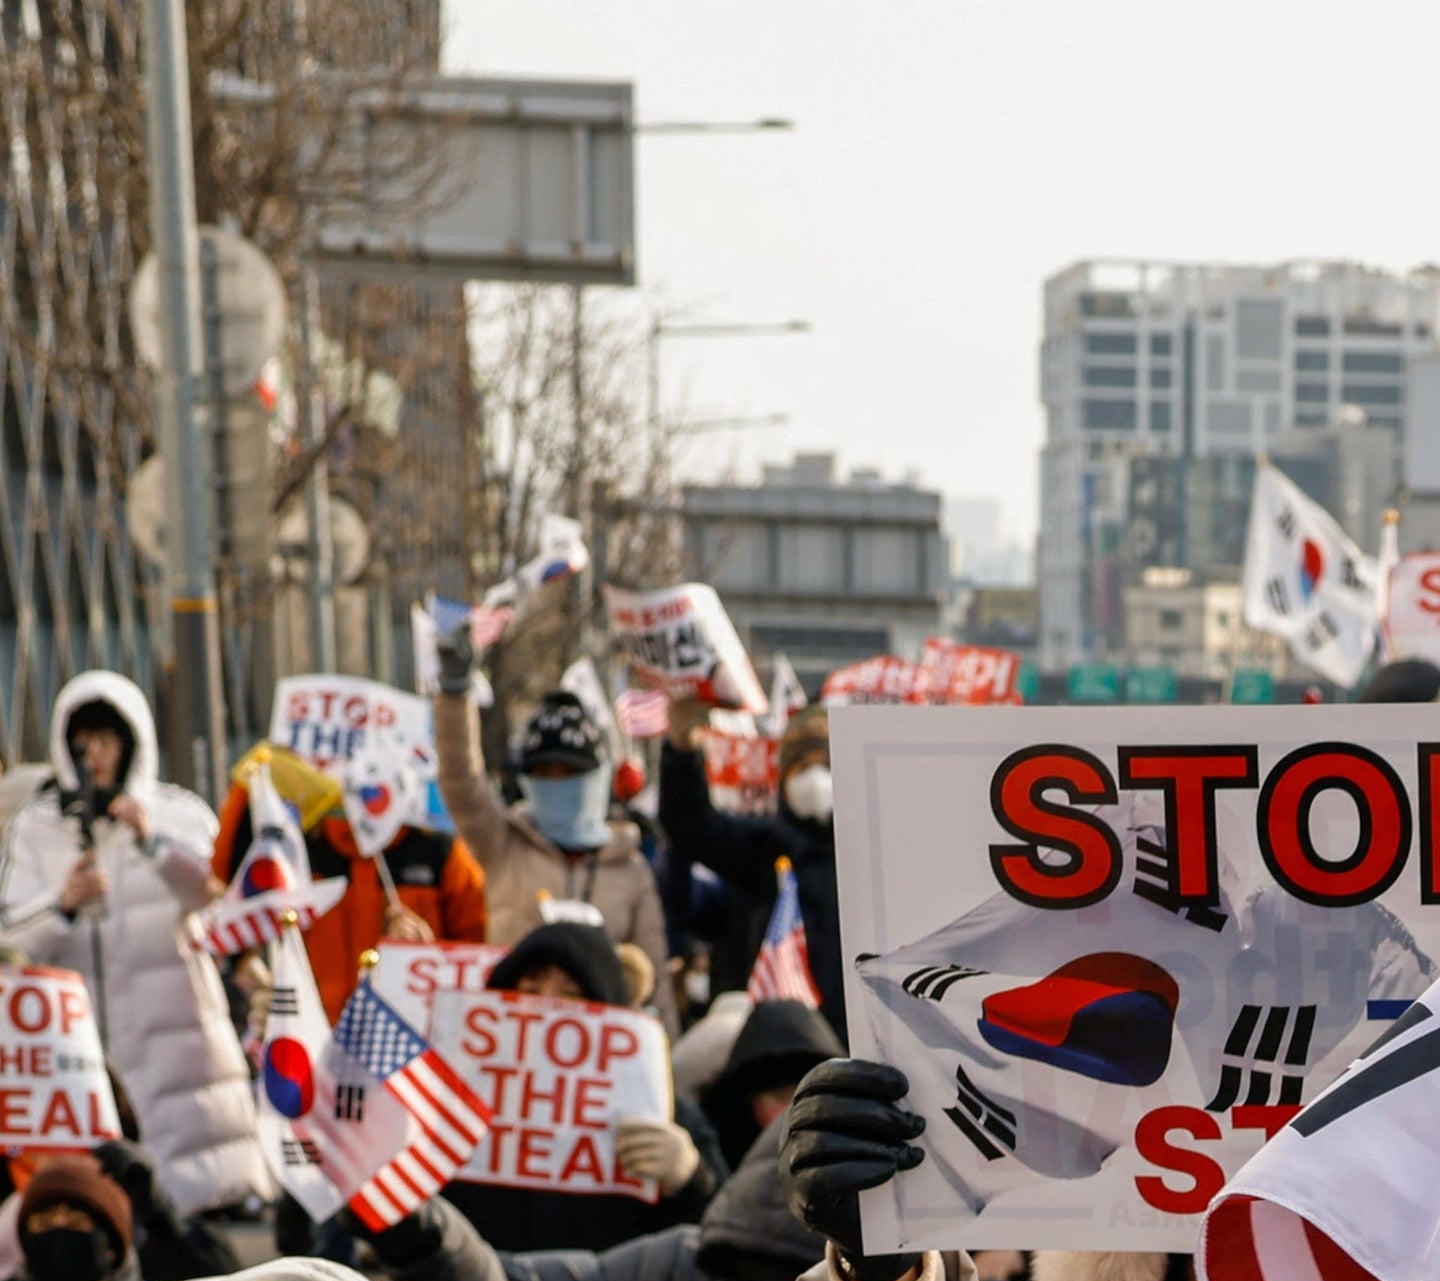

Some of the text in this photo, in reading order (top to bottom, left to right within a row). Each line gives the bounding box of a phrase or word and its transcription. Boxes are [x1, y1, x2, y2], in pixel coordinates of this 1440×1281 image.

[288, 689, 397, 728] STOP
[462, 1006, 641, 1073] STOP
[481, 1065, 614, 1131] THE
[488, 1124, 646, 1189] TEAL
